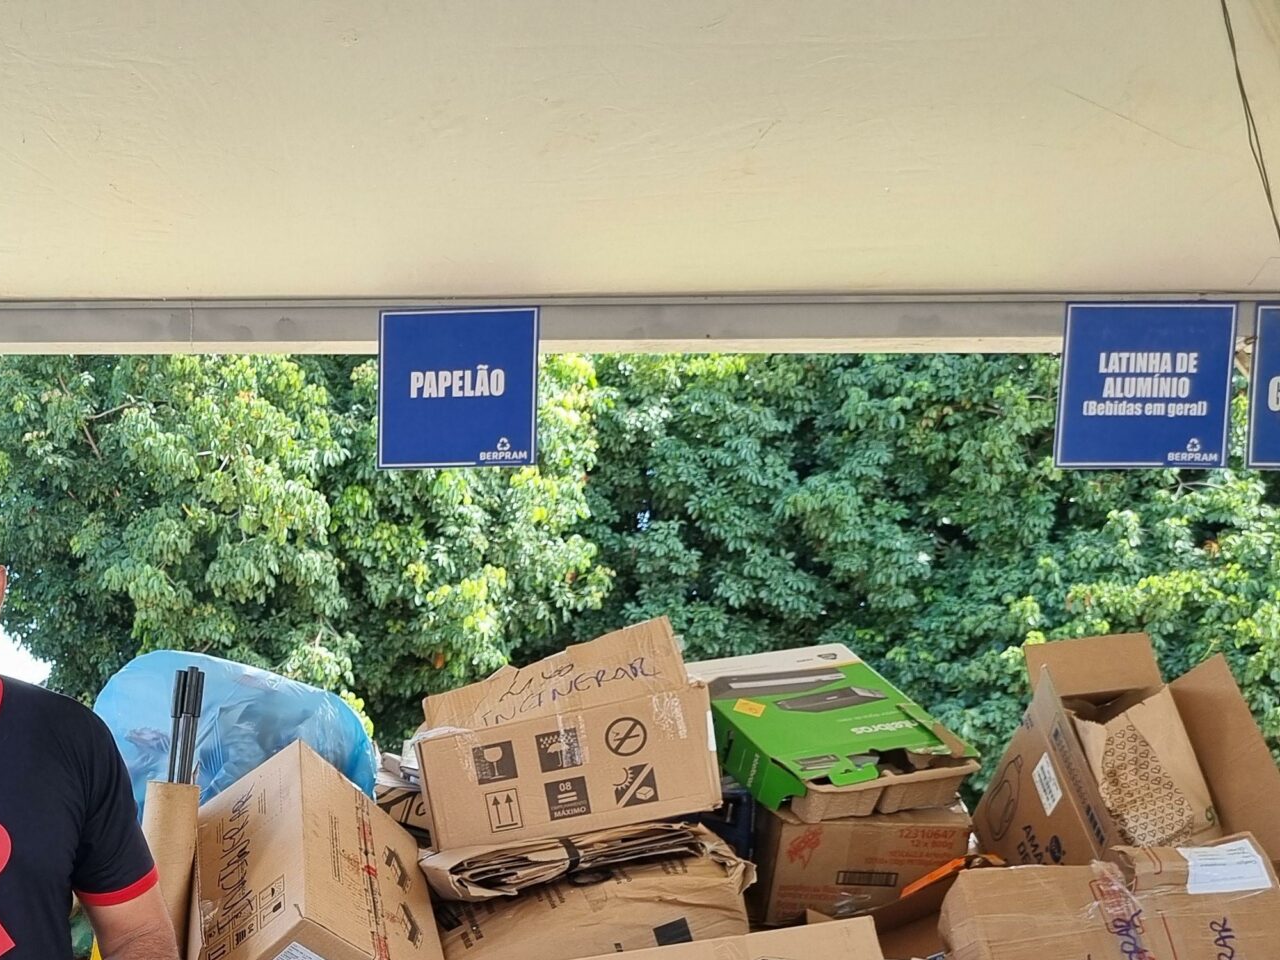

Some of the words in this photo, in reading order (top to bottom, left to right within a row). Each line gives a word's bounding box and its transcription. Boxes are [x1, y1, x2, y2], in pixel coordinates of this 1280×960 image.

[1099, 352, 1171, 373] LATINHA
[1176, 352, 1198, 373] DE
[410, 364, 505, 398] PAPELÃO
[1102, 373, 1190, 398] ALUMÍNIO
[1082, 401, 1142, 416] (Bebidas
[1144, 403, 1166, 416] em
[1167, 401, 1207, 417] geral)
[479, 451, 528, 461] BERPRAM
[1167, 452, 1218, 462] BERPRAM
[558, 781, 573, 792] 08
[554, 806, 587, 818] MÁXIMO
